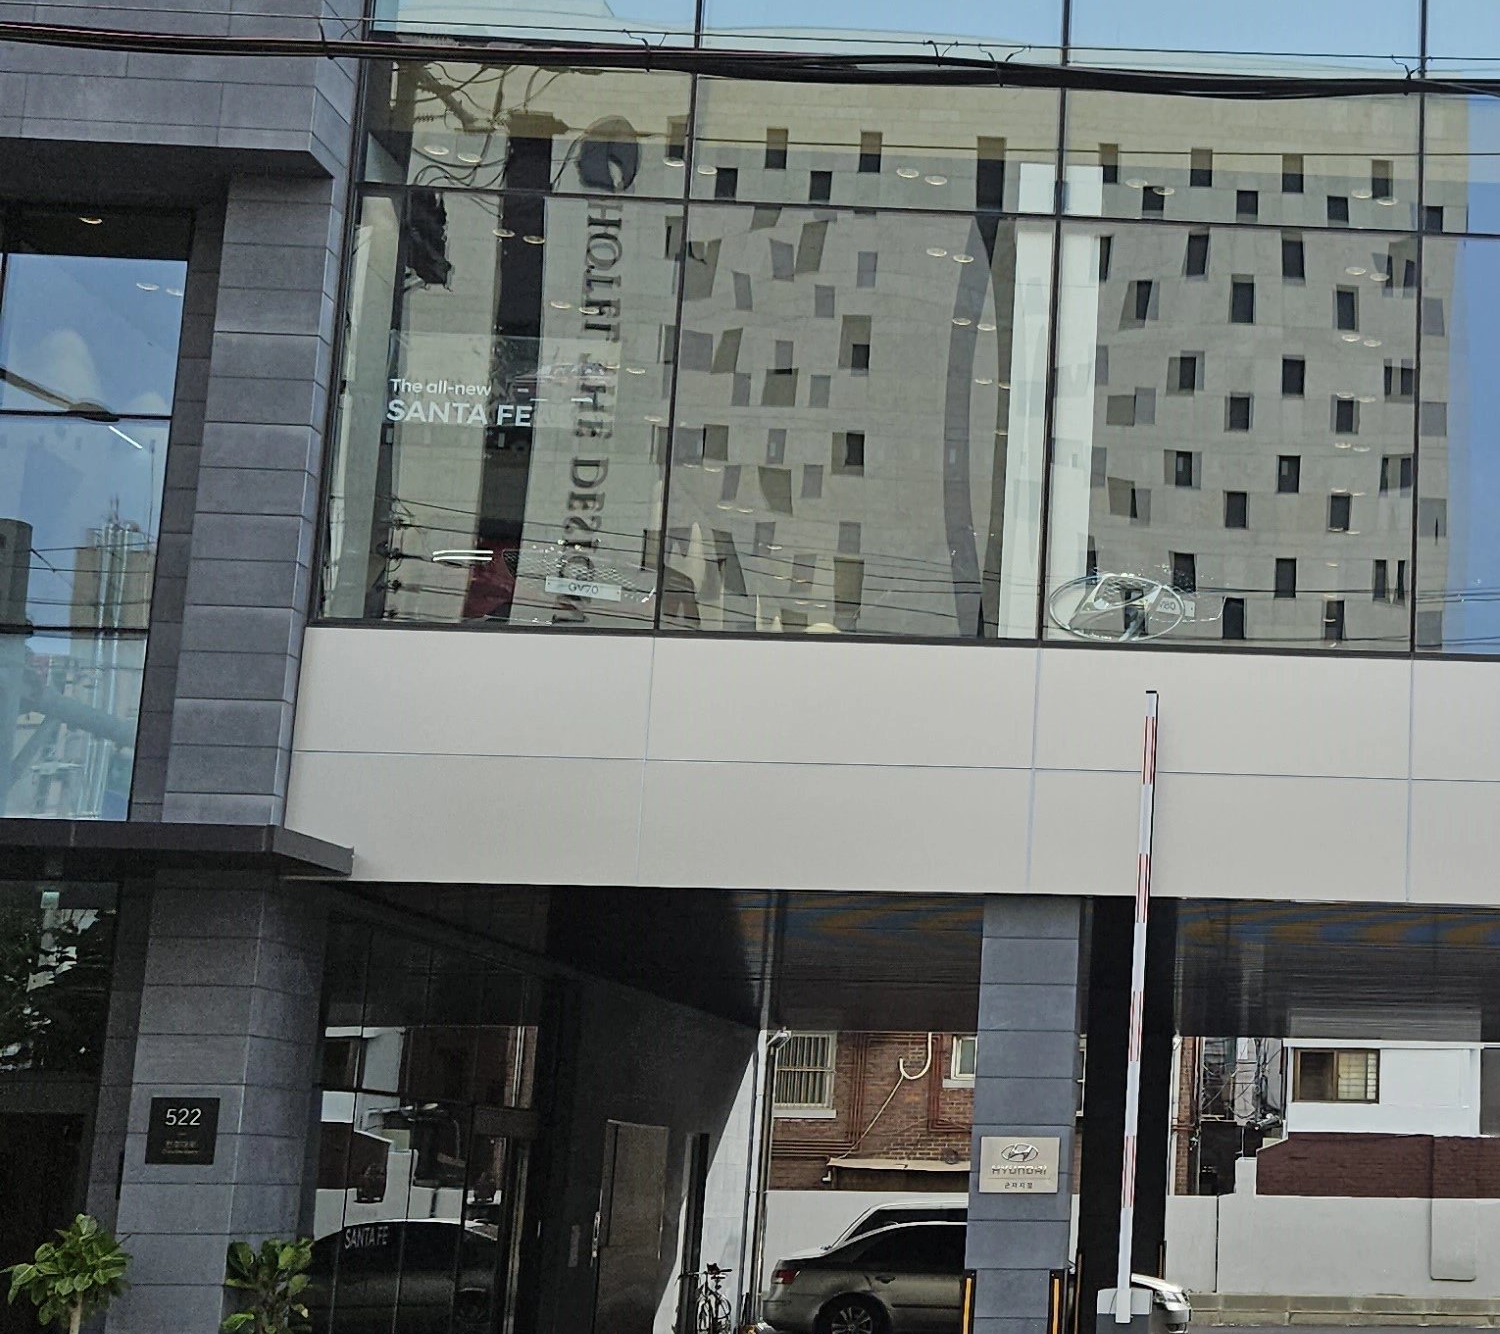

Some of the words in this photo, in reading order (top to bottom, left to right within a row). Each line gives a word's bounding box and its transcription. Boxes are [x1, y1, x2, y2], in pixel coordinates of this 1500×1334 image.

[390, 378, 423, 393] The
[426, 380, 492, 396] all-new
[386, 399, 488, 425] SANTA
[497, 404, 533, 427] FE
[165, 1108, 201, 1126] 522
[992, 1164, 1047, 1175] HYUNDAI
[345, 1227, 375, 1249] SANTA
[377, 1225, 389, 1246] FE
